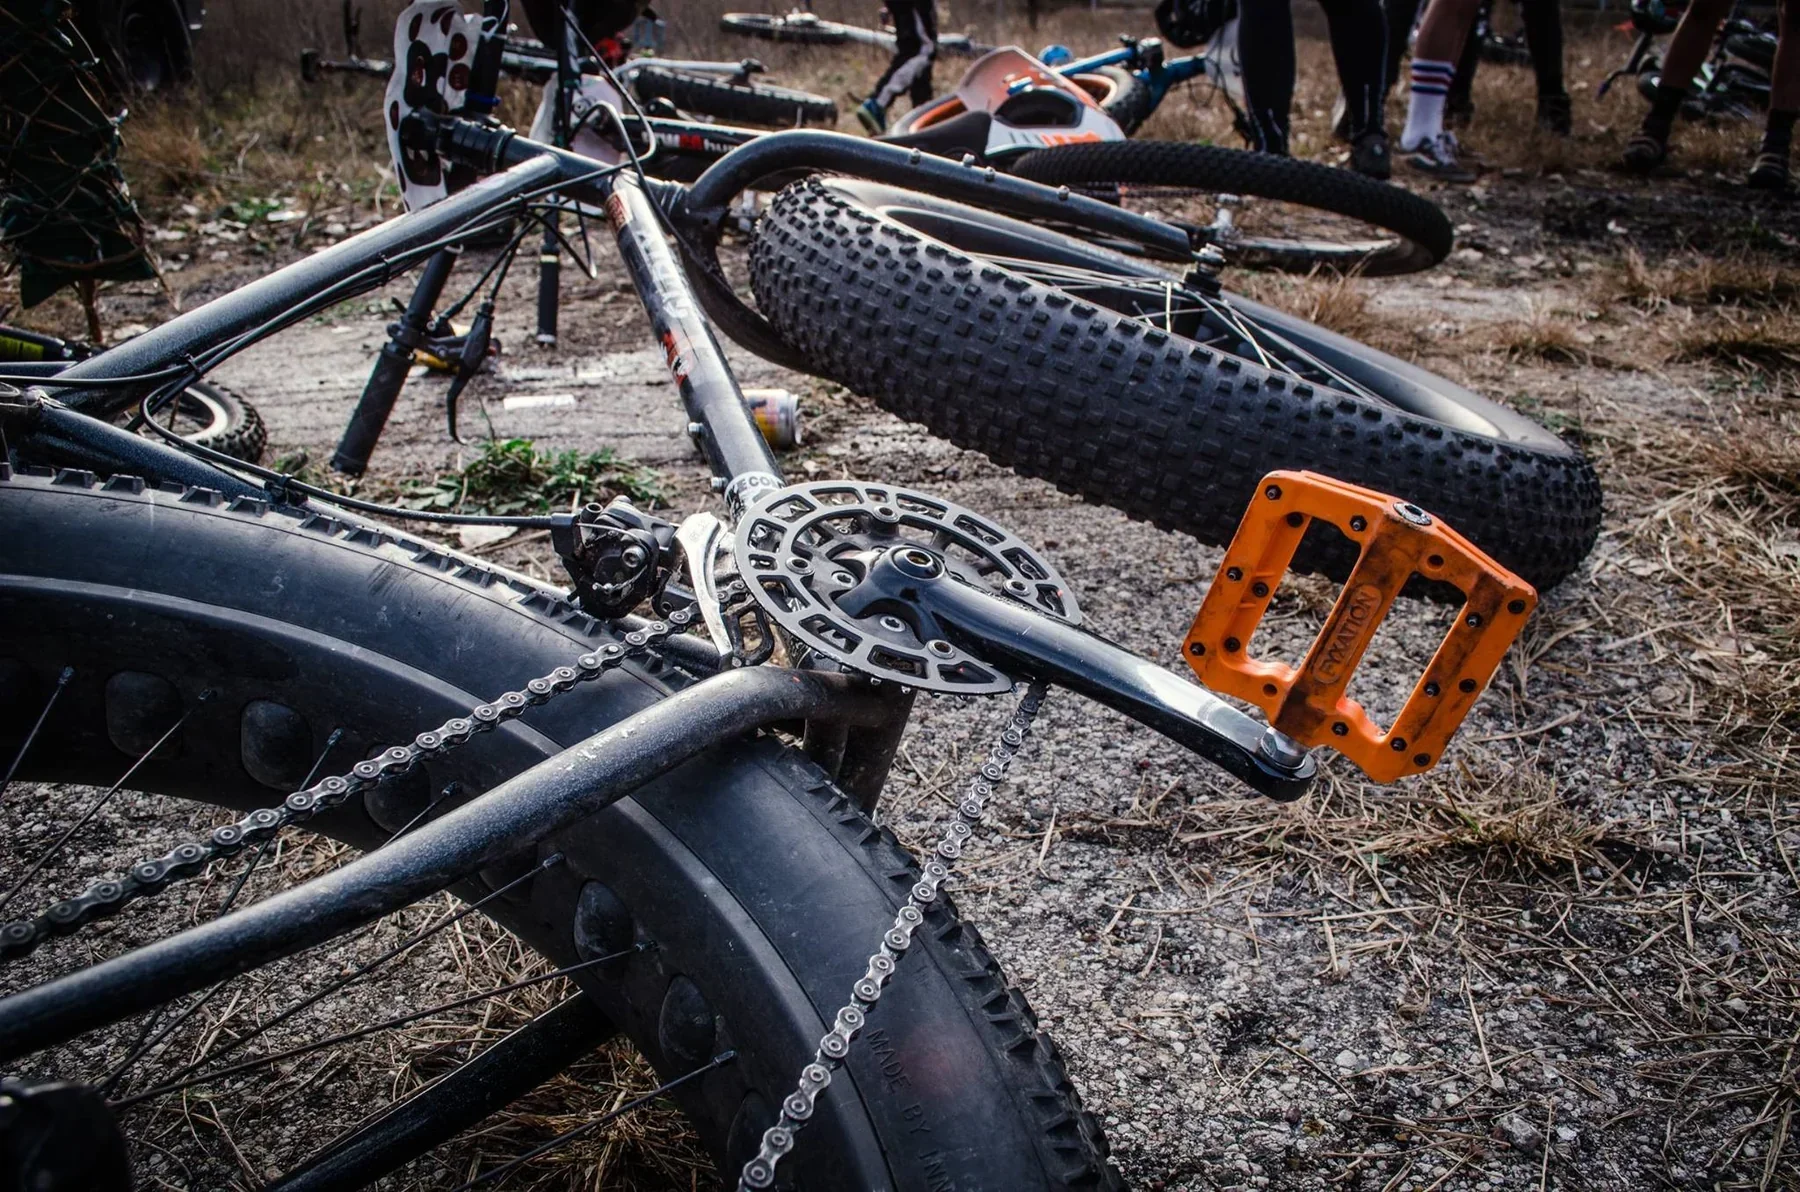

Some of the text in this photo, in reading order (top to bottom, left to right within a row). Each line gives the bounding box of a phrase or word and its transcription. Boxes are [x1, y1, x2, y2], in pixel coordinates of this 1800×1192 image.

[1319, 591, 1377, 676] FYXATION
[866, 1028, 912, 1094] MADE
[903, 1102, 932, 1134] BY
